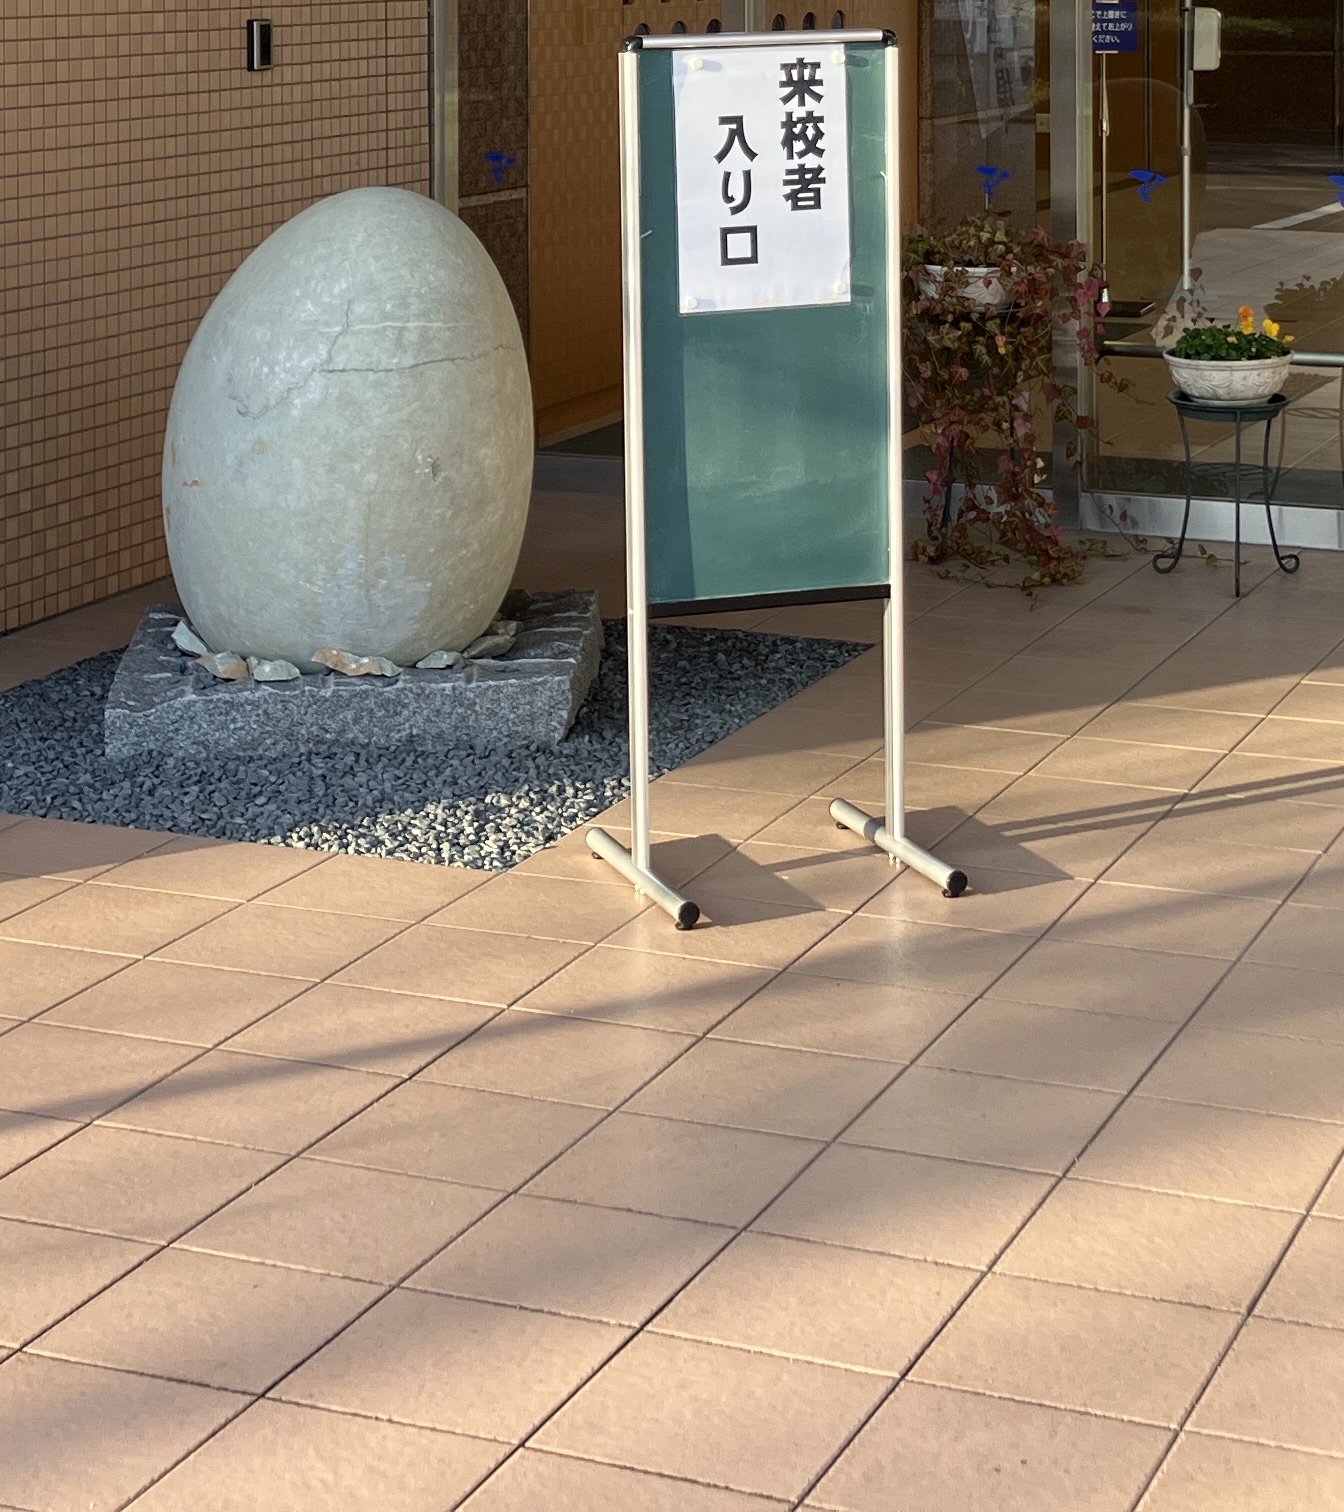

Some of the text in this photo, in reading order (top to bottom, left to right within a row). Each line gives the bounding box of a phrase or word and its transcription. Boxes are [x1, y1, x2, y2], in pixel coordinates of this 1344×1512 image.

[713, 115, 759, 266] 入り口
[778, 57, 827, 211] 来校者
